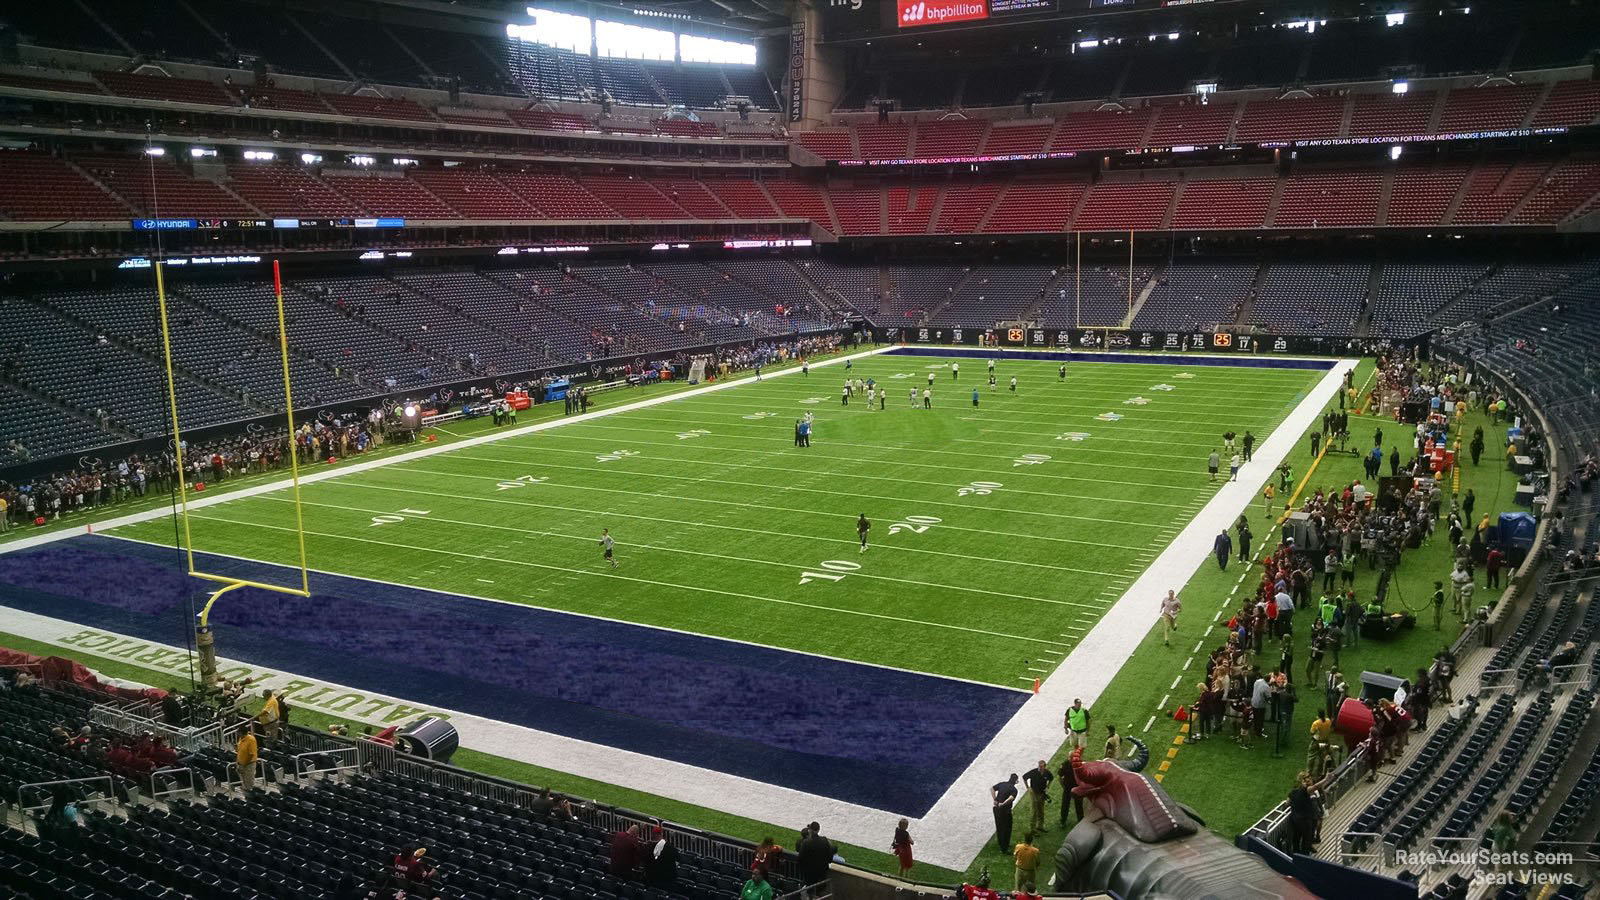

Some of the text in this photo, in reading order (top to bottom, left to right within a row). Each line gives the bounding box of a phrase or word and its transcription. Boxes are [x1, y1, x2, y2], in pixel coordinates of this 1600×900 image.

[927, 4, 983, 19] bhpbilliton
[792, 41, 804, 80] HOU
[792, 88, 801, 121] 78247
[1436, 133, 1480, 141] MERCHANDISE
[1010, 330, 1021, 340] 25
[1033, 334, 1044, 342] 90
[1058, 334, 1069, 342] 99
[1216, 335, 1229, 345] 25
[1166, 336, 1178, 345] 25
[1193, 337, 1204, 346] 75
[1239, 340, 1248, 348] 17
[1274, 340, 1287, 349] 29
[496, 474, 550, 489] 20
[957, 481, 1004, 495] 30
[371, 508, 432, 524] 10
[888, 515, 943, 534] 20
[801, 560, 862, 582] 10
